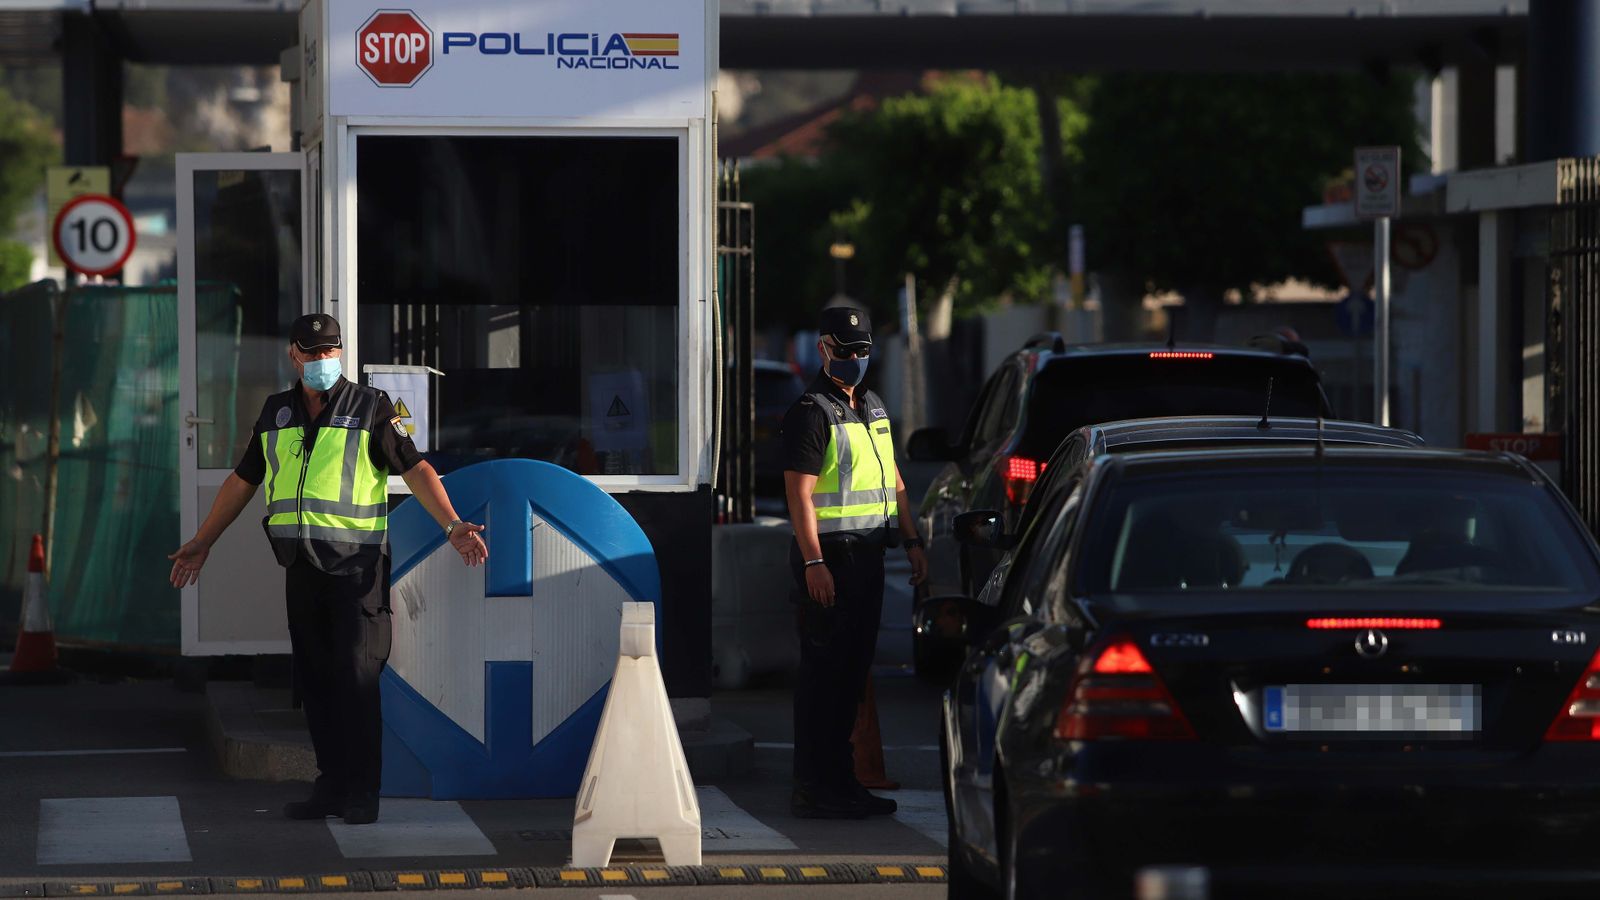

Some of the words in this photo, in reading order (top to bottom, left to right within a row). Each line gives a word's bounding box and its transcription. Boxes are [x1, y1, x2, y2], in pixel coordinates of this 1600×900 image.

[364, 32, 426, 65] STOP
[557, 57, 680, 70] NACIONAL
[70, 217, 118, 252] 10
[1488, 438, 1541, 455] STOP
[1551, 630, 1587, 645] CDI
